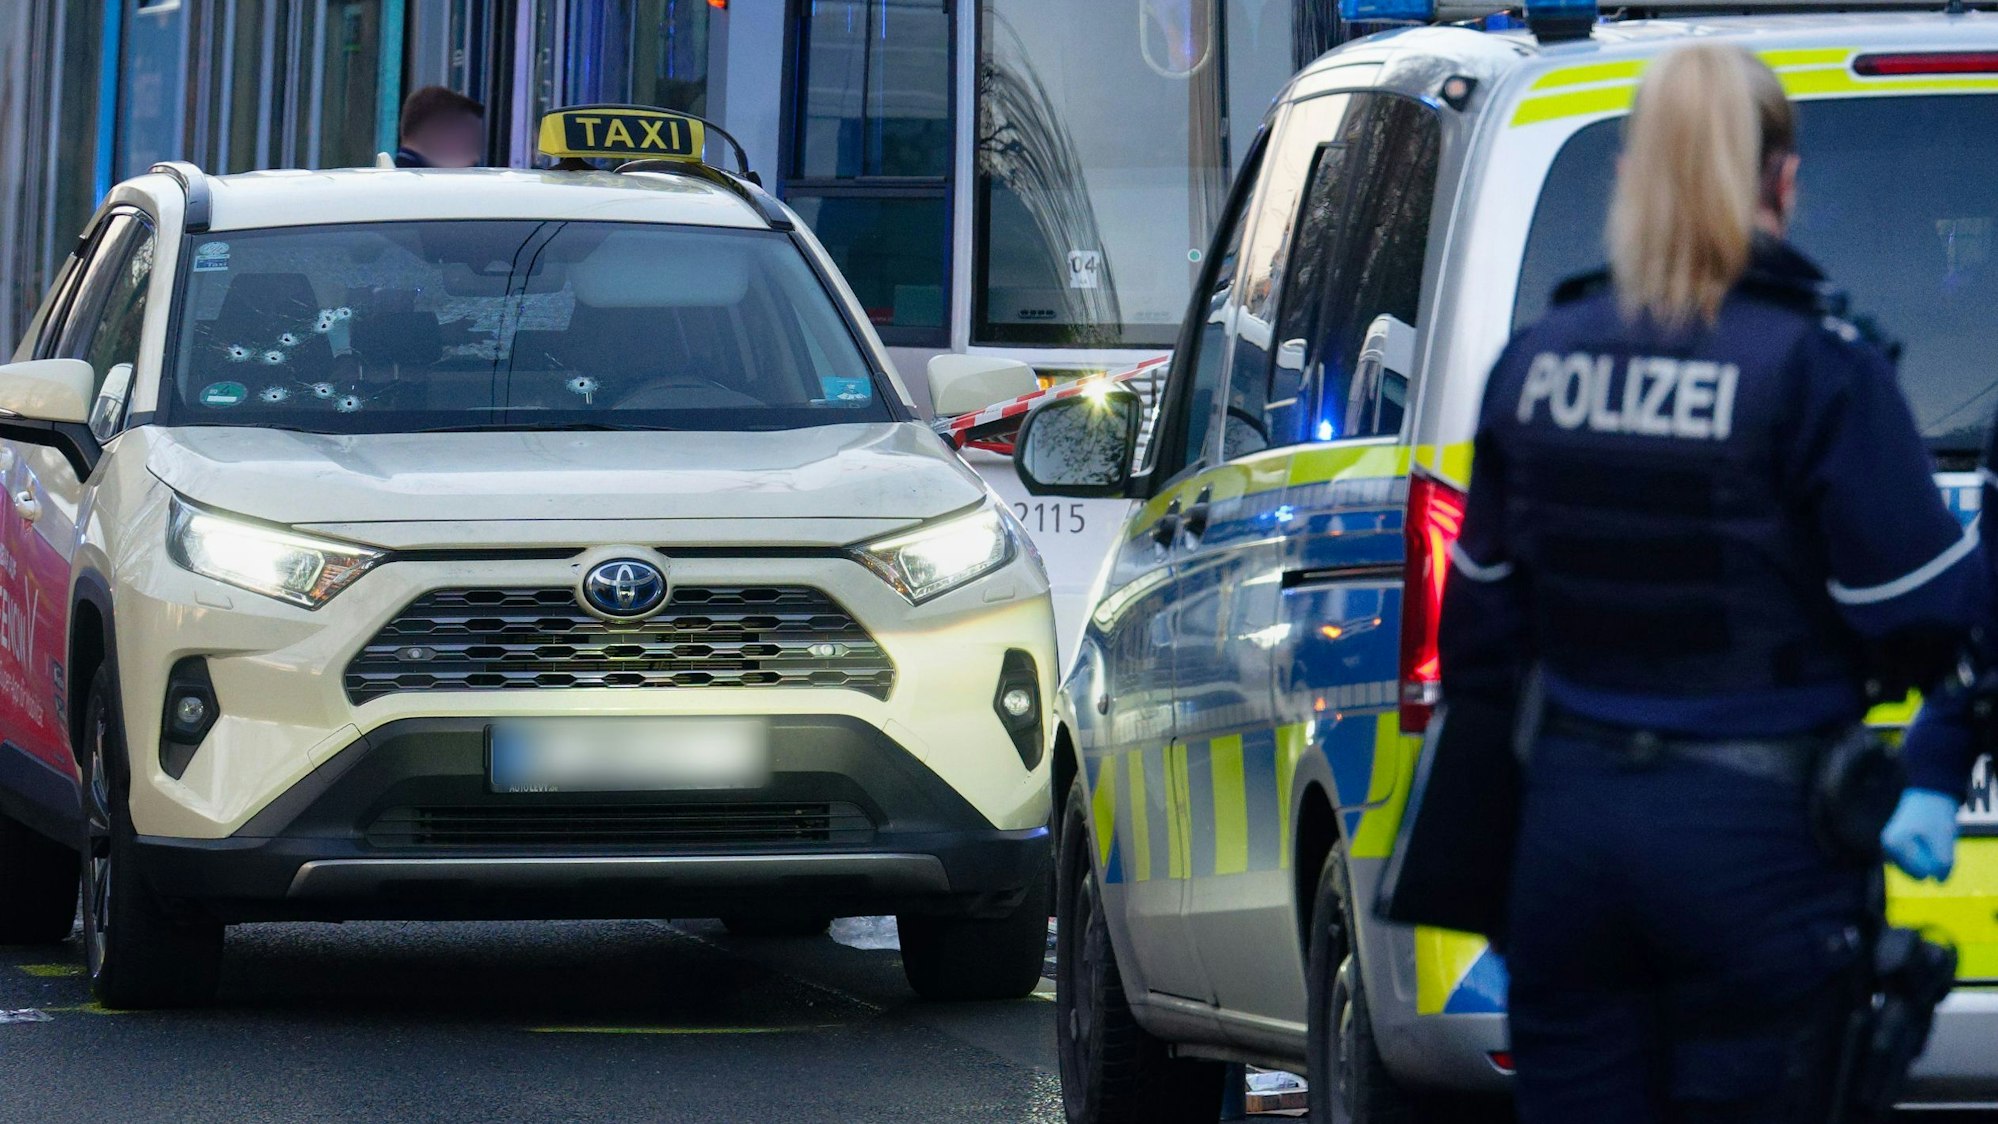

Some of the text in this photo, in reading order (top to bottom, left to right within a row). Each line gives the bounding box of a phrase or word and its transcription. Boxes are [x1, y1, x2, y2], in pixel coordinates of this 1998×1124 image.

[575, 117, 681, 150] TAXI
[1071, 256, 1098, 273] 04
[1516, 352, 1740, 441] POLIZEI
[1014, 502, 1085, 533] 2115
